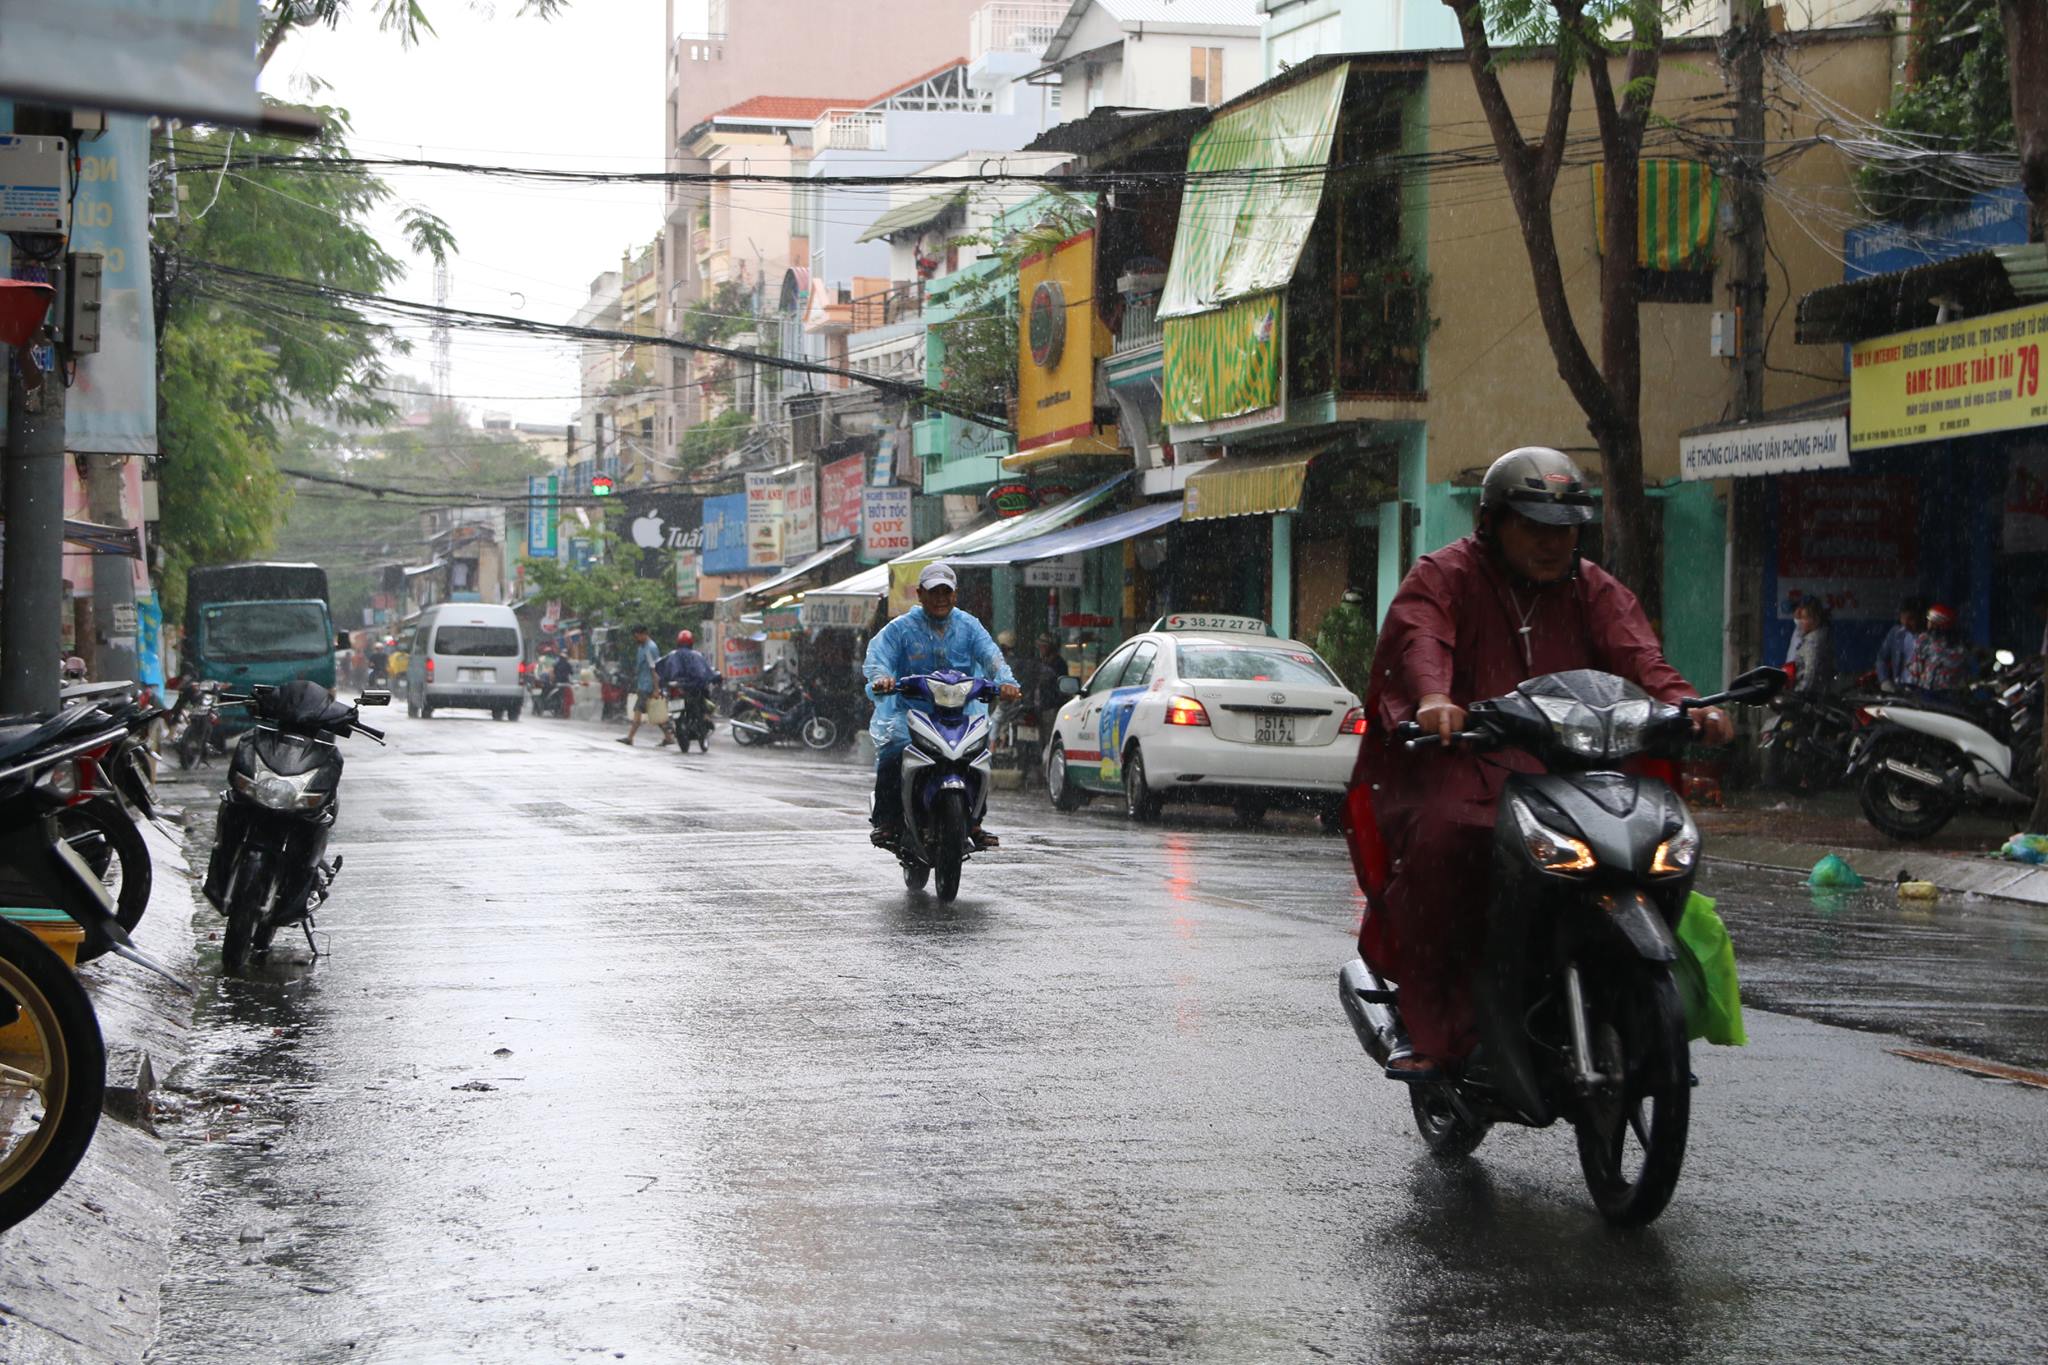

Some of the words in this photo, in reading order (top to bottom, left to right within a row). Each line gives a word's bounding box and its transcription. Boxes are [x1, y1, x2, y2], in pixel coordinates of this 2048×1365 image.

[1906, 368, 1932, 396] GAME
[1935, 362, 1967, 391] ONLINE
[2017, 343, 2039, 398] 79
[1686, 445, 1696, 472] HỆ
[1697, 441, 1722, 467] THỐNG
[1723, 439, 1740, 464] CỬA
[1740, 437, 1763, 463] HÀNG
[1764, 435, 1781, 460] VĂN
[1782, 433, 1811, 458] PHÒNG
[1812, 426, 1837, 454] PHẨM
[872, 518, 904, 535] QUÝ
[868, 536, 909, 549] LONG
[1190, 617, 1225, 628] 38.27
[1229, 619, 1244, 629] 27
[1248, 620, 1263, 631] 27
[1265, 717, 1286, 729] 51A
